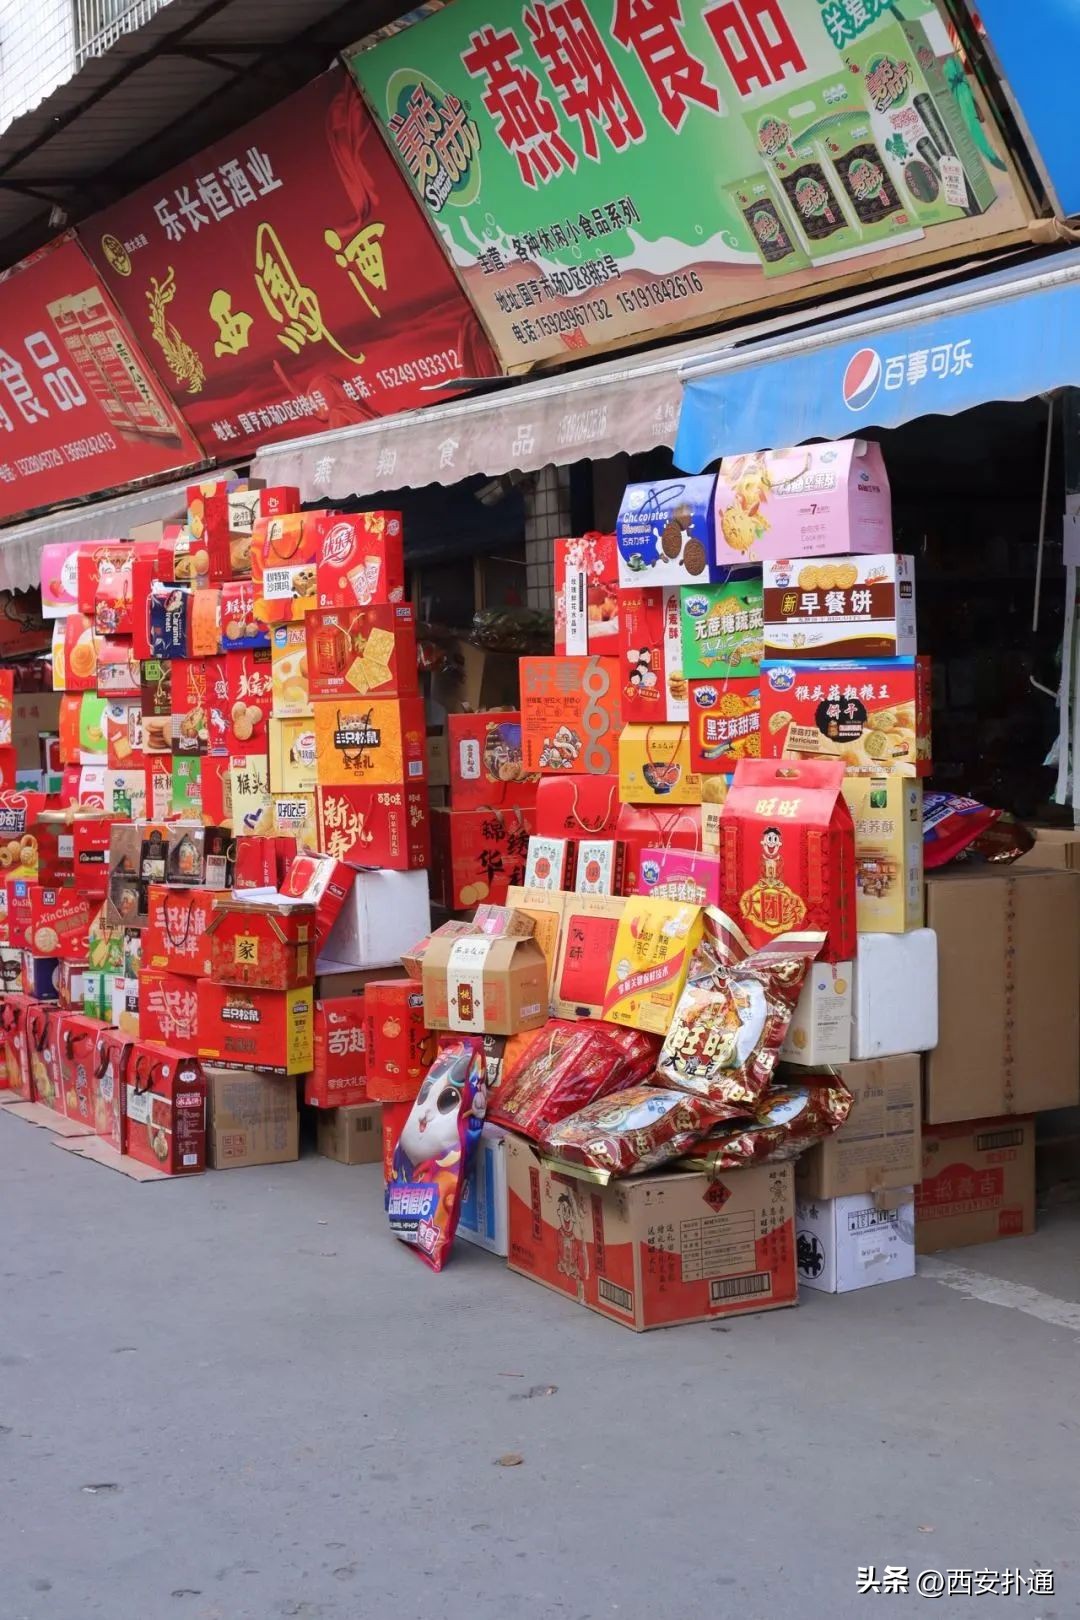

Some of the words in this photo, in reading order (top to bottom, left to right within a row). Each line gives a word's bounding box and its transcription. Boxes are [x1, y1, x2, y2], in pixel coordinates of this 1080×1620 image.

[460, 0, 808, 189] 燕翔食品
[152, 147, 283, 242] 乐长恒酒业
[616, 271, 703, 313] 15191842616
[883, 338, 974, 391] 百事可乐
[781, 593, 797, 614] 新
[800, 591, 873, 614] 早餐饼
[826, 703, 858, 719] 饼干
[336, 732, 379, 746] 三只松鼠
[377, 793, 402, 807] 百草味
[755, 797, 803, 818] 旺旺
[155, 906, 206, 933] 三只松鼠
[239, 940, 255, 960] 家
[222, 1008, 260, 1022] 三只松鼠
[673, 1025, 736, 1059] 旺旺
